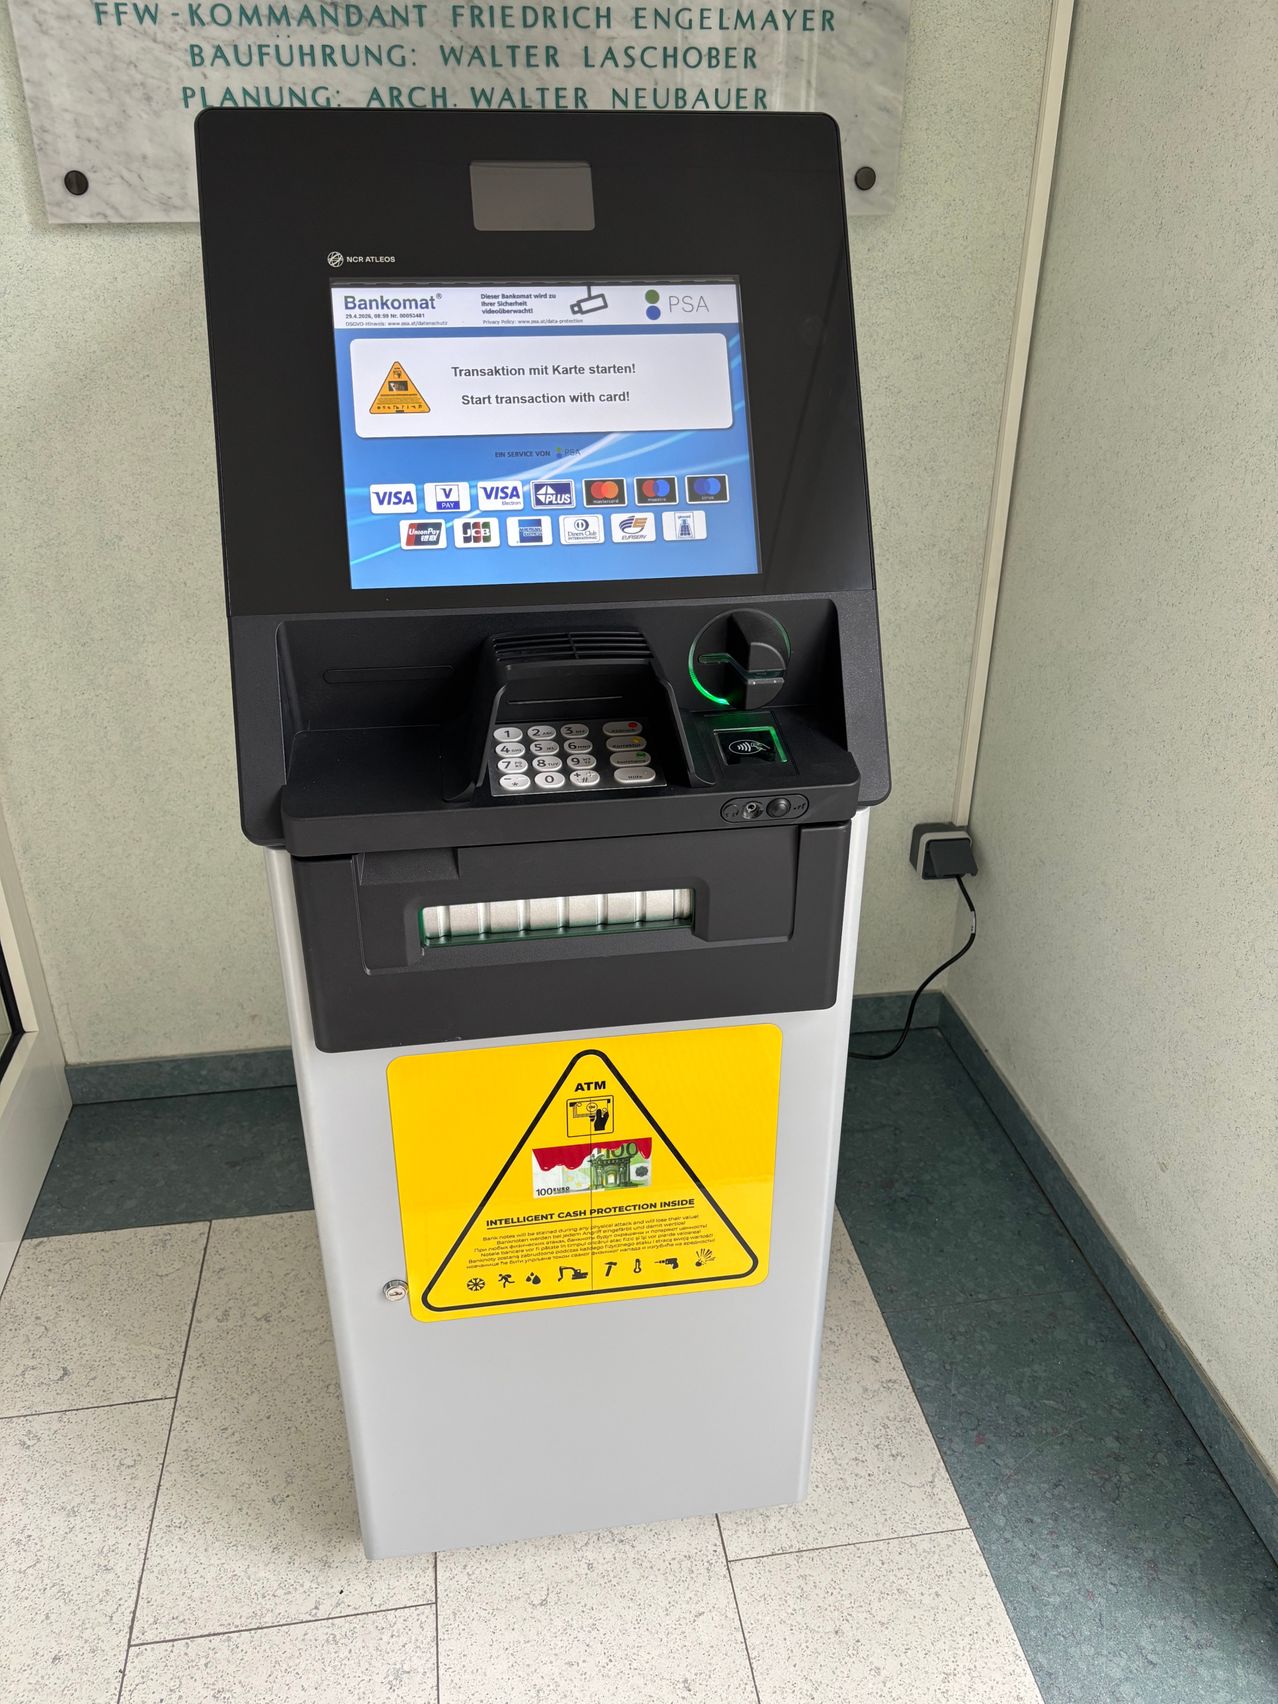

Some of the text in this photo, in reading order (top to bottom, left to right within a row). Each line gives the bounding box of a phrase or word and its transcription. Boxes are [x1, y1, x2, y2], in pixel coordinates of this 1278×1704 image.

[451, 4, 613, 29] FRIEDRICH
[633, 6, 836, 32] ENGELMAYER
[188, 34, 757, 70] BAUFÜHRUNG: WALTER LASCHOBER
[182, 86, 768, 111] PLANUNG: ARCH. WALTER NEUBAUER
[668, 295, 710, 313] PSA
[451, 363, 636, 377] Transaktion mit Karte starten!
[461, 391, 630, 406] Start transaction with card!
[441, 488, 453, 499] V
[480, 486, 520, 500] VISA
[372, 491, 414, 506] VISA
[546, 493, 571, 504] PLUS
[408, 528, 440, 537] UnionPay
[462, 528, 490, 537] JCB
[532, 728, 540, 736] 2
[564, 726, 573, 735] 3
[500, 745, 510, 753] 4
[534, 743, 543, 752] 5
[568, 741, 577, 750] 6
[501, 761, 512, 769] 7
[536, 759, 547, 768] 8
[571, 757, 580, 766] 9
[545, 775, 555, 783] 0
[574, 1080, 606, 1092] ATM
[536, 1188, 553, 1196] 100
[486, 1198, 695, 1226] INTELLIGENT CASH PROTECTION INSIDE
